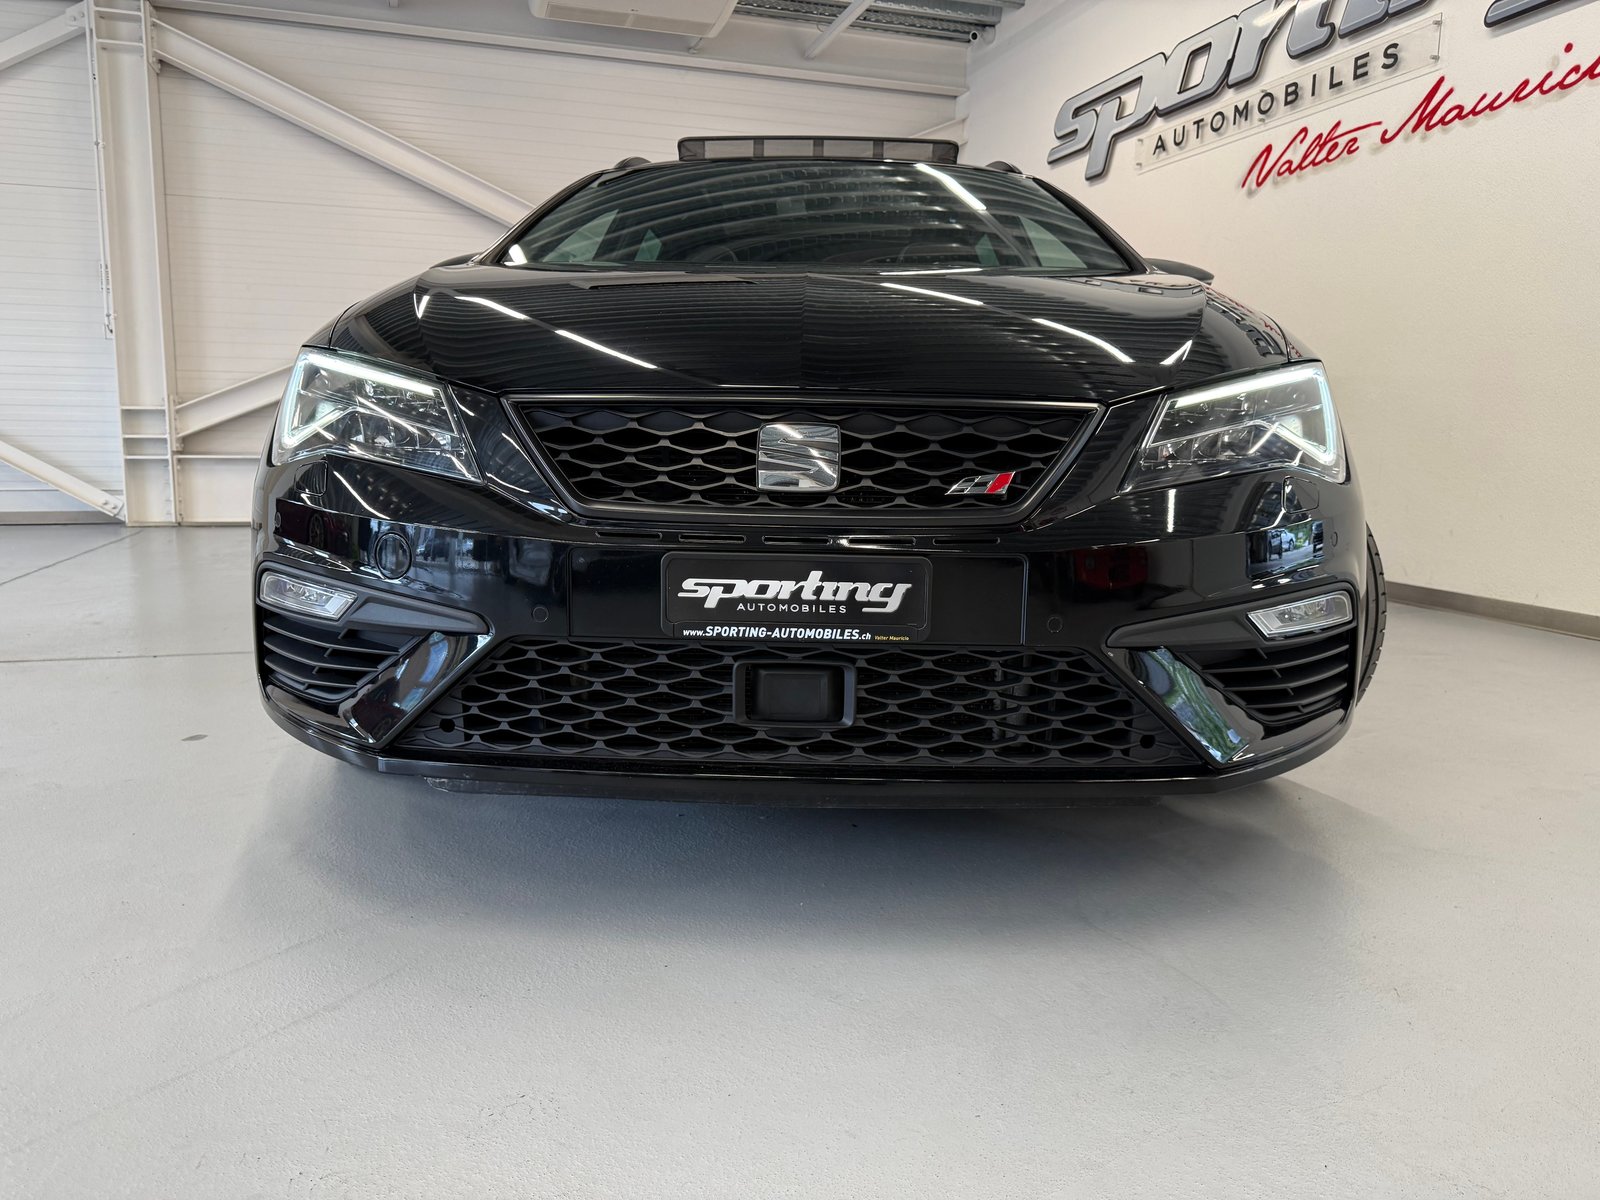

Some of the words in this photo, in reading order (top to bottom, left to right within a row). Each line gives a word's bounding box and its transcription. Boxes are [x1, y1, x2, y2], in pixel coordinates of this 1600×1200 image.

[1047, 0, 1567, 182] sport
[1152, 42, 1400, 156] AUTOMOBILES
[677, 570, 912, 613] sporting
[737, 602, 847, 613] AUTOMOBILES
[683, 625, 871, 640] www.SPORTING-AUTOMOBILES.ch
